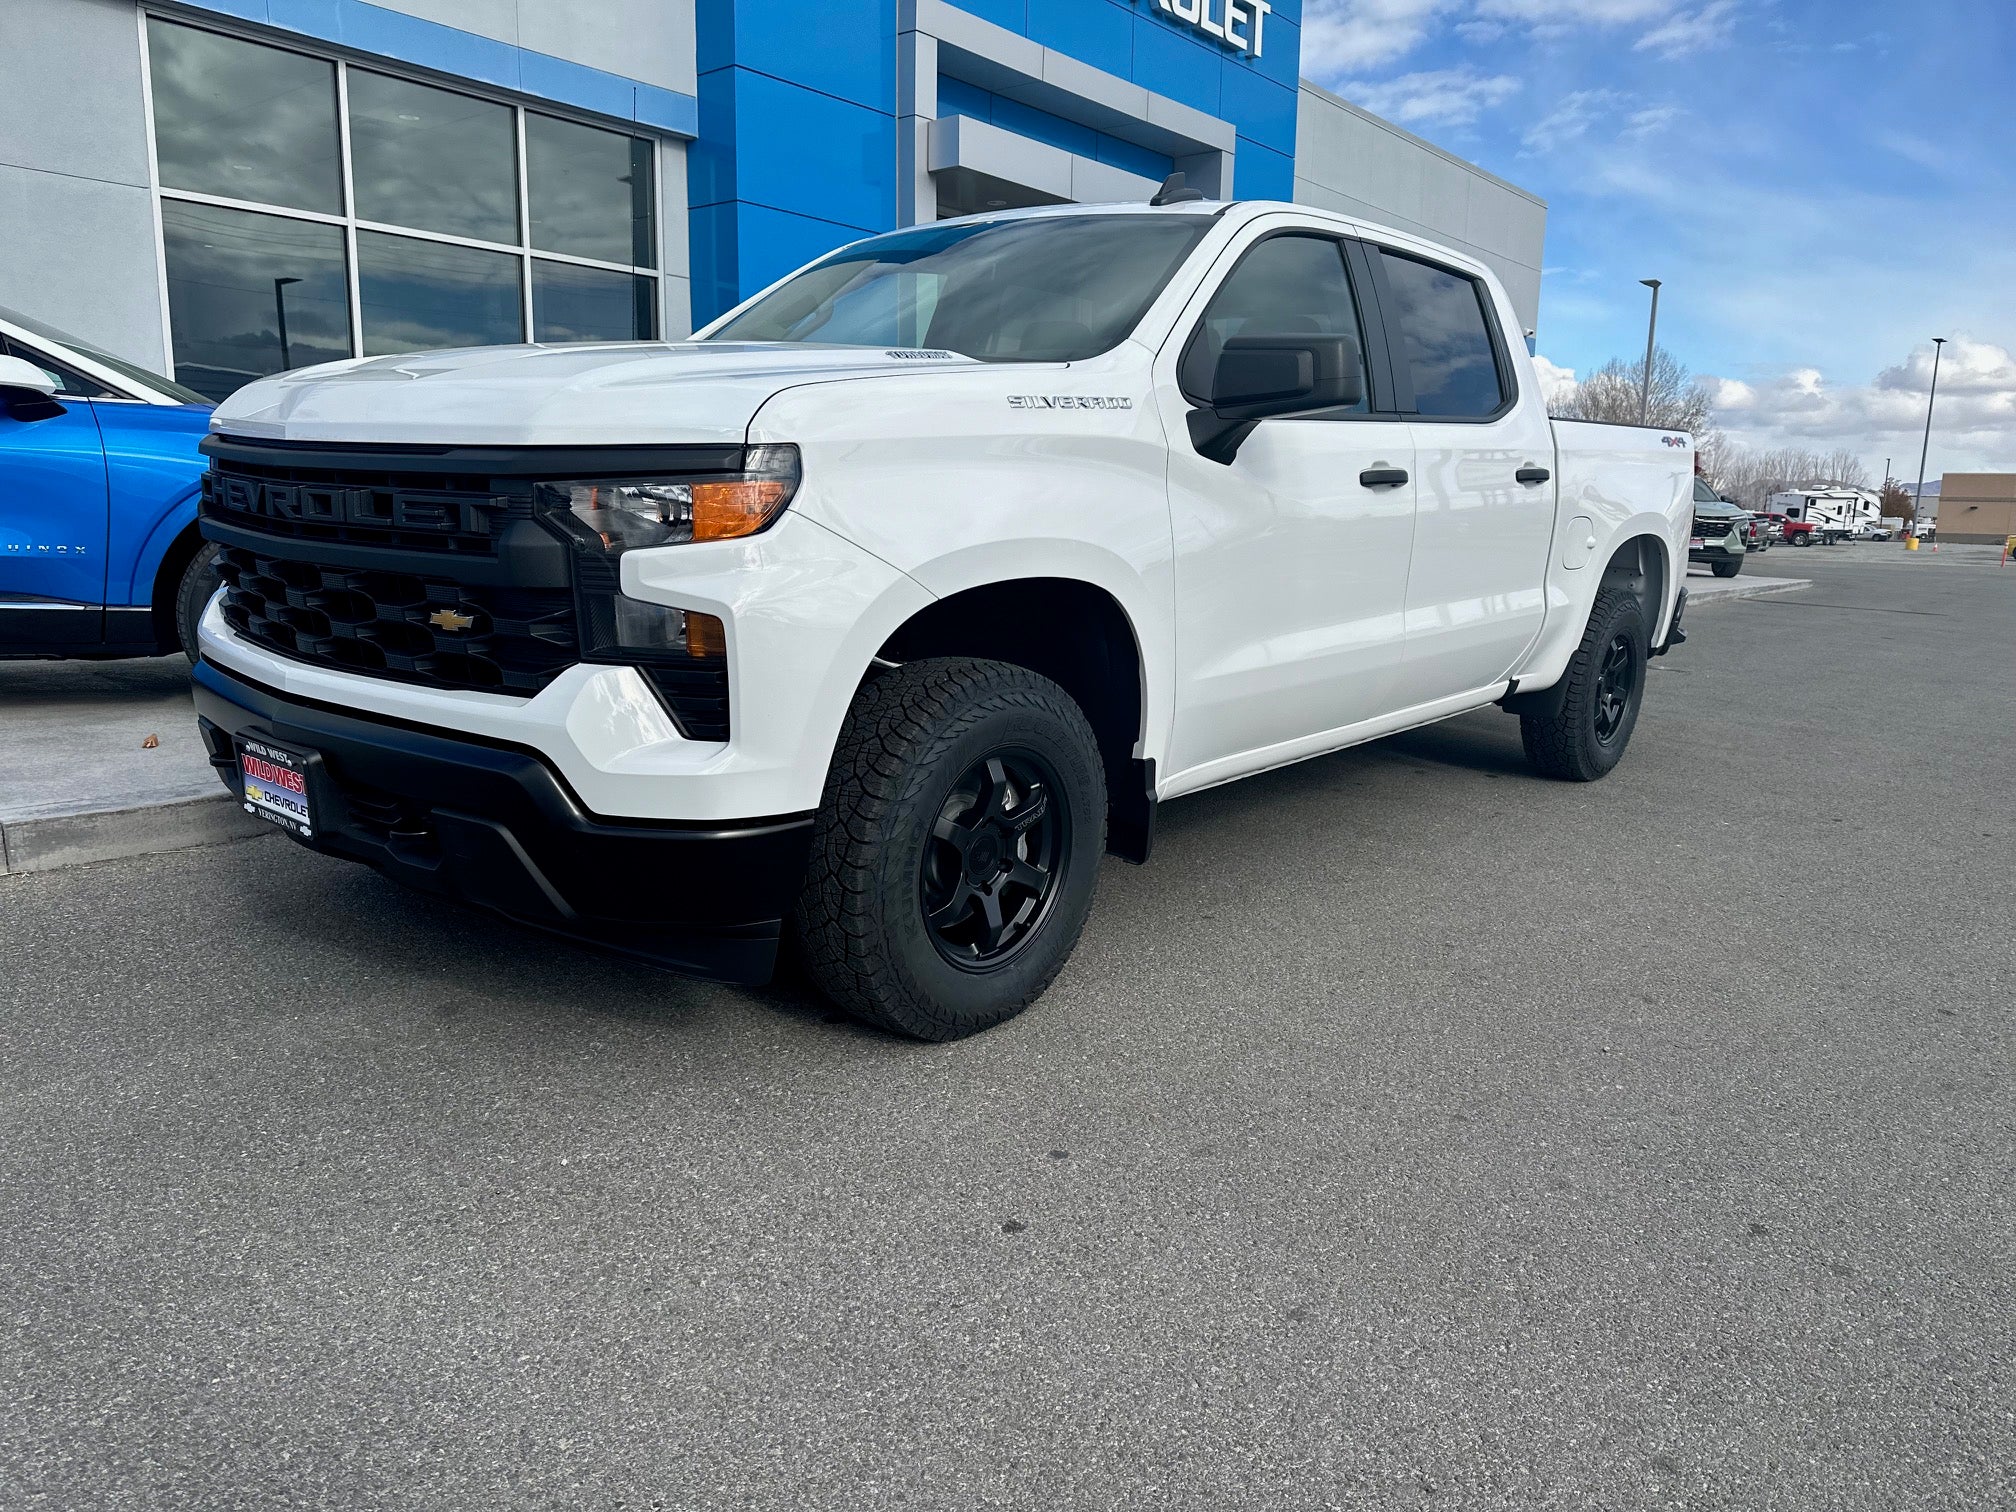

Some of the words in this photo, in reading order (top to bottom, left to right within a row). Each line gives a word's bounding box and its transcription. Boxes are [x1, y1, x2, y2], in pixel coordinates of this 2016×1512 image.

[1158, 0, 1271, 57] OLET
[1007, 396, 1133, 409] SILVERADO
[201, 469, 509, 534] CHEVROLET
[248, 741, 267, 756] WILD
[264, 791, 308, 817] CHEVROLE
